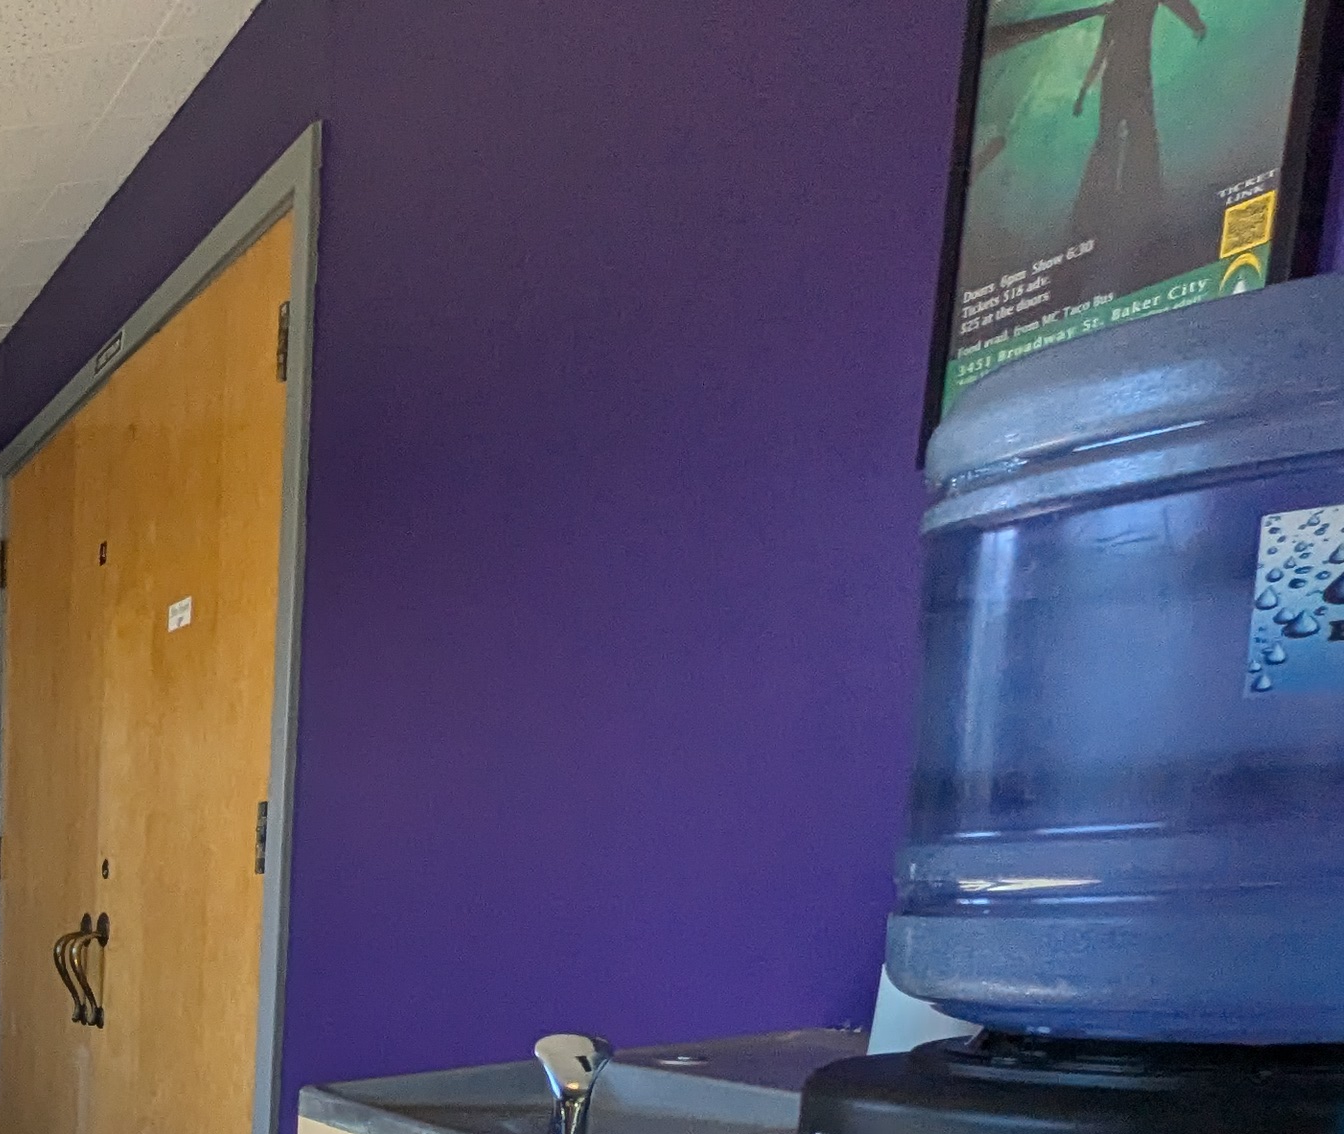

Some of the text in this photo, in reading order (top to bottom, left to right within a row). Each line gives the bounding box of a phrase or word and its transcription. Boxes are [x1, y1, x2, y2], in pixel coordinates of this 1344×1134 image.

[1217, 167, 1278, 197] TICKET
[1225, 185, 1265, 206] LINK
[1032, 252, 1064, 275] Show
[961, 294, 1000, 319] Tickets
[995, 305, 1014, 321] the
[1062, 300, 1092, 319] Taco
[998, 327, 1076, 360] Broadway
[1111, 294, 1161, 322] Baker
[1167, 277, 1210, 300] City
